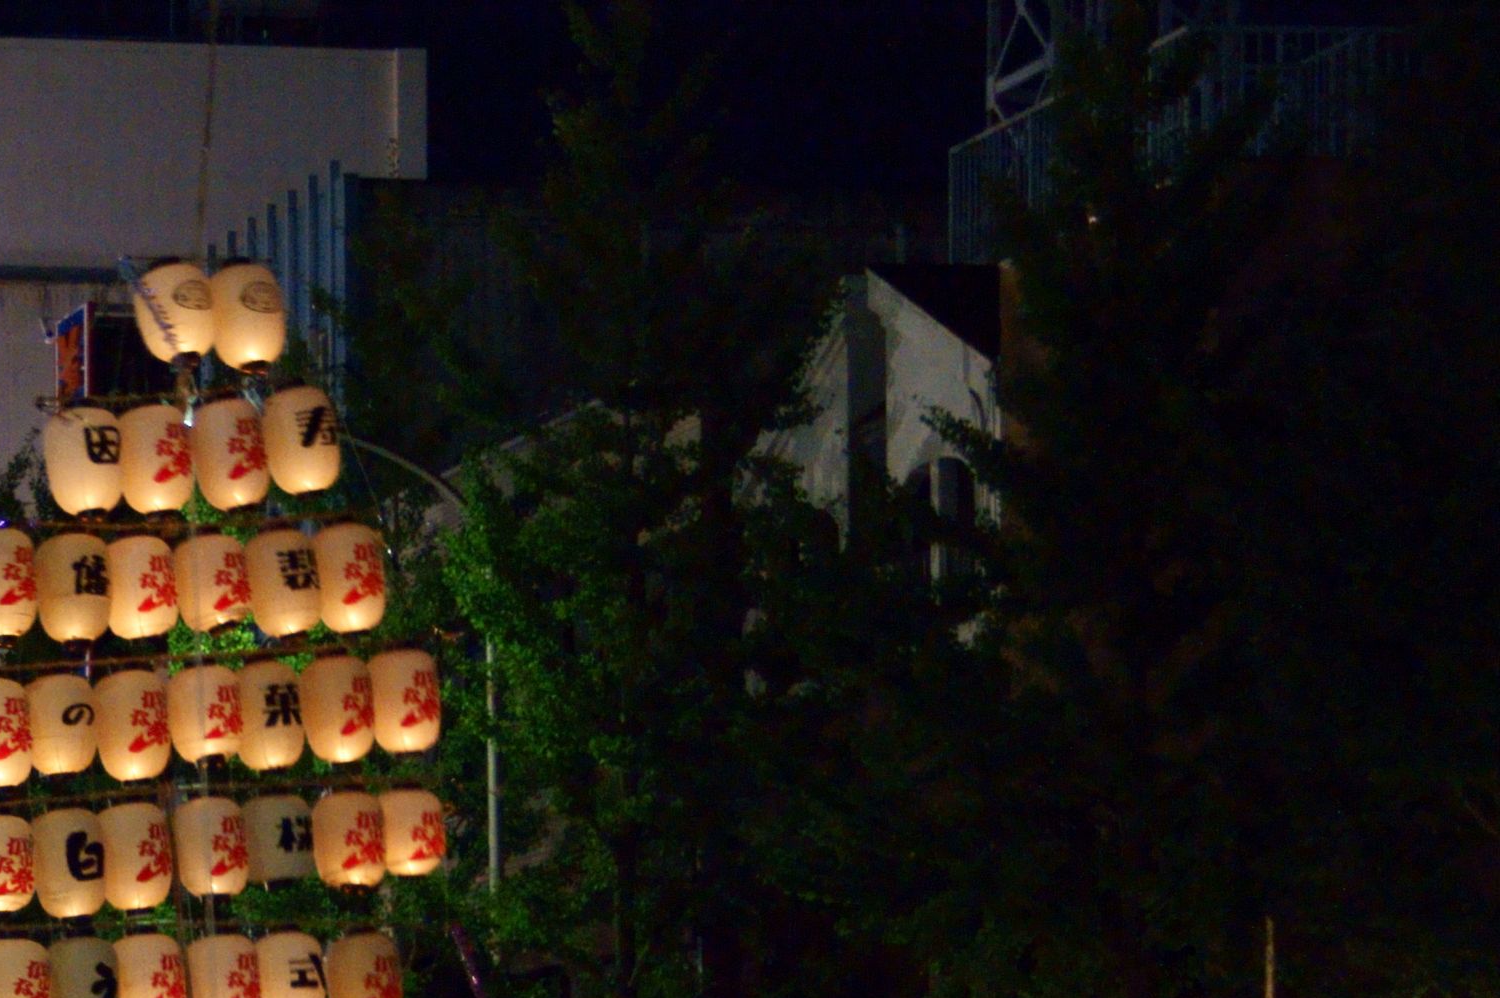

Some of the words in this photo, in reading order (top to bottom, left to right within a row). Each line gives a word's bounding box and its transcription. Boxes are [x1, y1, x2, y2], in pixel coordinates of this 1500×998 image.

[84, 425, 120, 465] 因
[295, 406, 338, 447] 寿
[62, 702, 95, 726] の
[66, 832, 105, 881] 白
